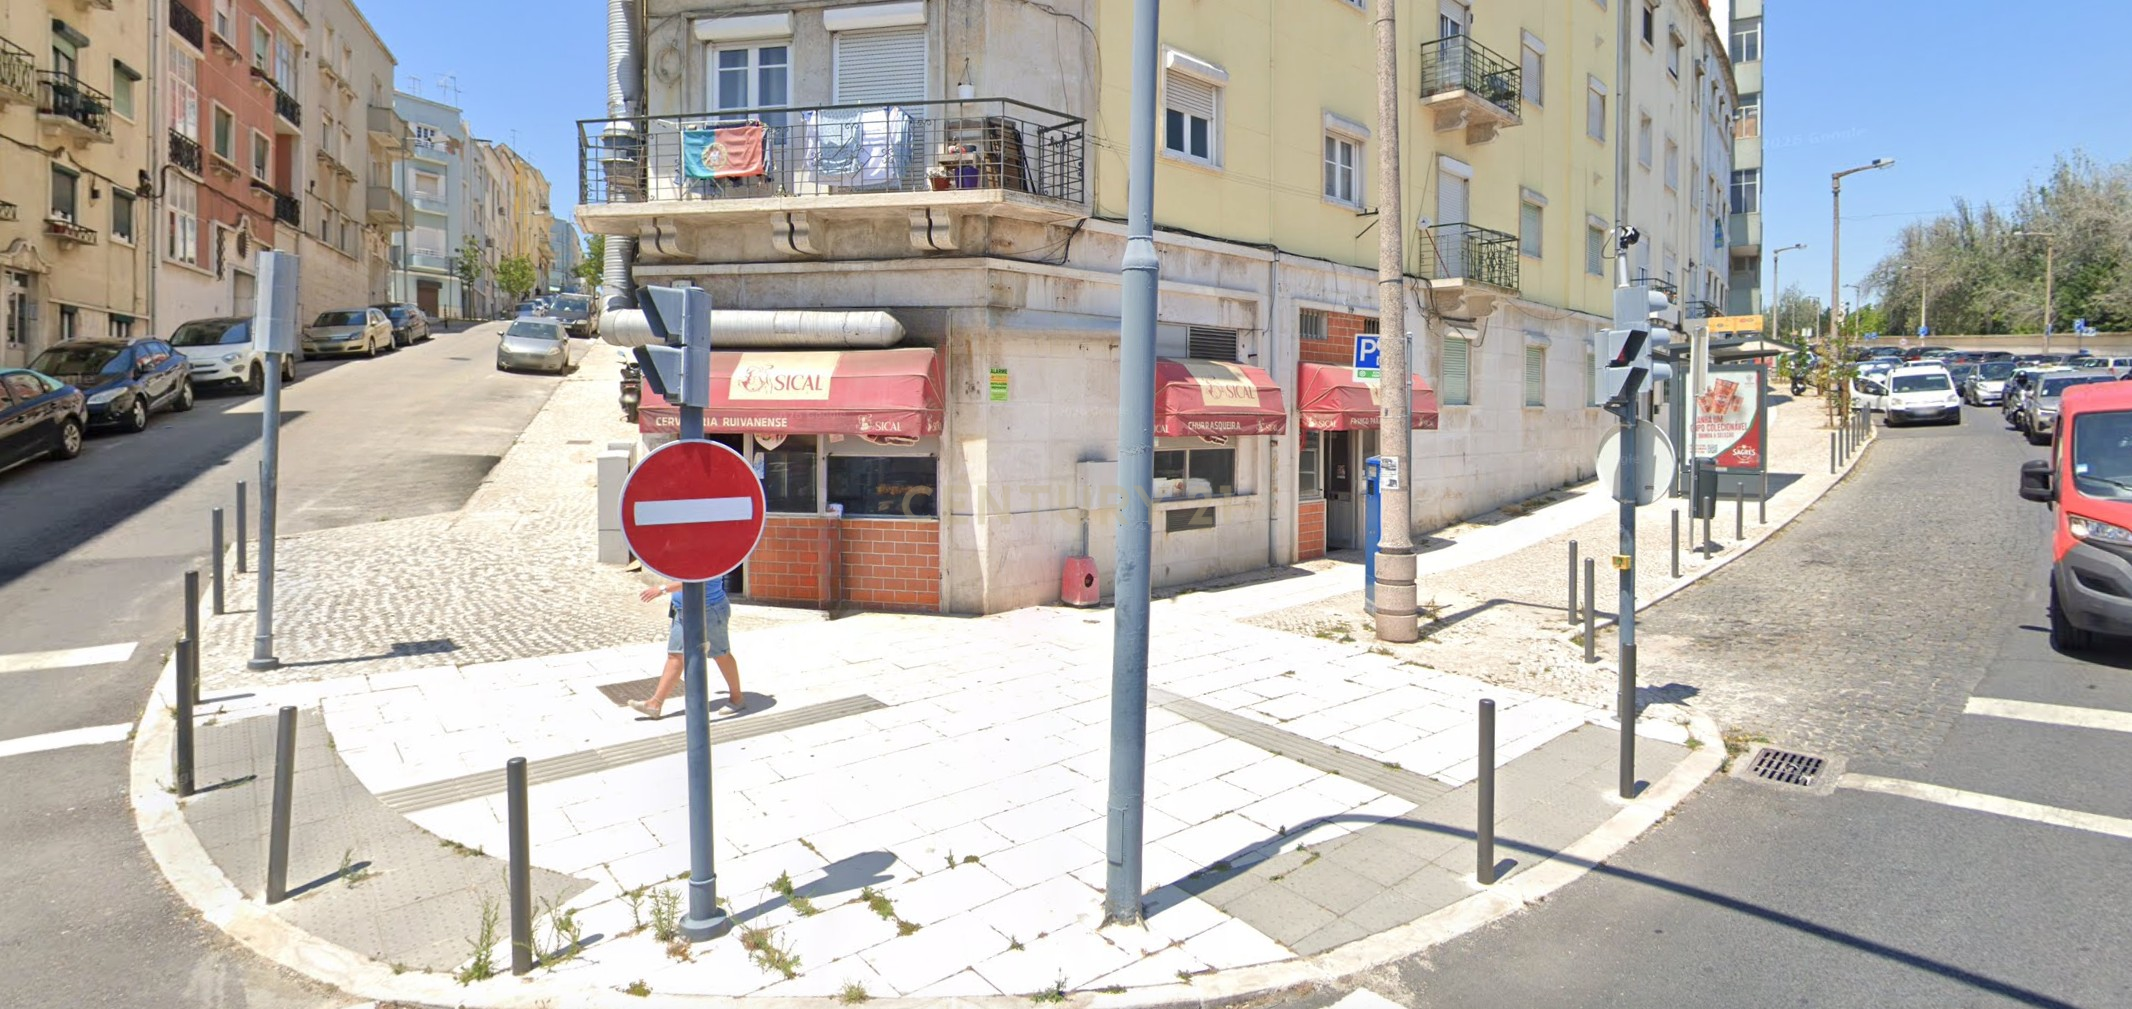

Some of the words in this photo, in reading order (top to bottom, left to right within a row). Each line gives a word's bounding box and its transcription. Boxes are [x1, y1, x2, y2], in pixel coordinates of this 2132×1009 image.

[774, 374, 823, 391] SICAL
[1226, 385, 1256, 399] SICAL
[655, 416, 718, 427] CERVIA
[723, 416, 788, 428] RUIVANENSE
[875, 421, 902, 432] SICAL
[1188, 421, 1241, 430] CHURRASQUEIRA
[1732, 448, 1756, 456] SAGRES
